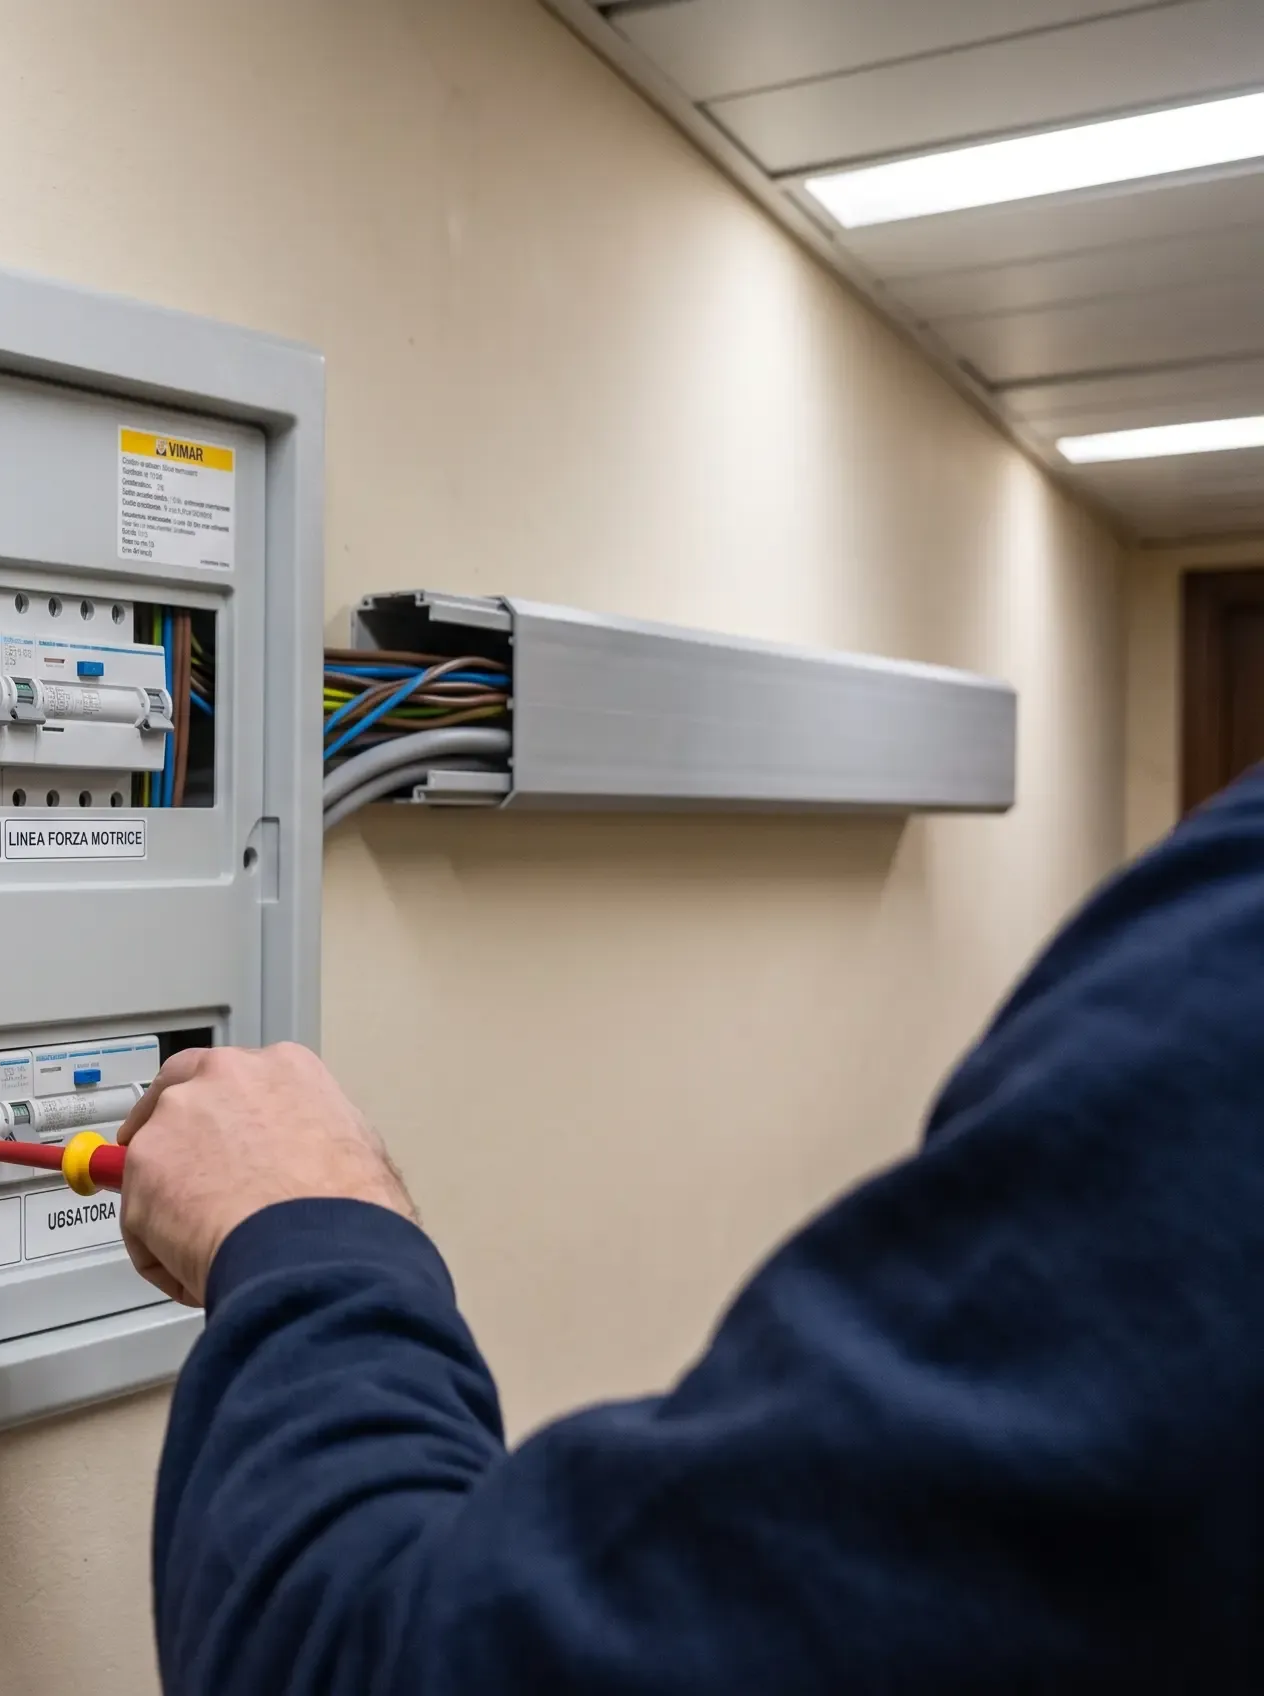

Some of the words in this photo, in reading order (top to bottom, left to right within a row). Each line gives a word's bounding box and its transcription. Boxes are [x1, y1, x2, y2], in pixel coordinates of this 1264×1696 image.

[168, 442, 204, 462] VIMAR
[8, 831, 46, 847] LINEA
[48, 831, 89, 846] FORZA
[91, 831, 143, 846] MOTRICE
